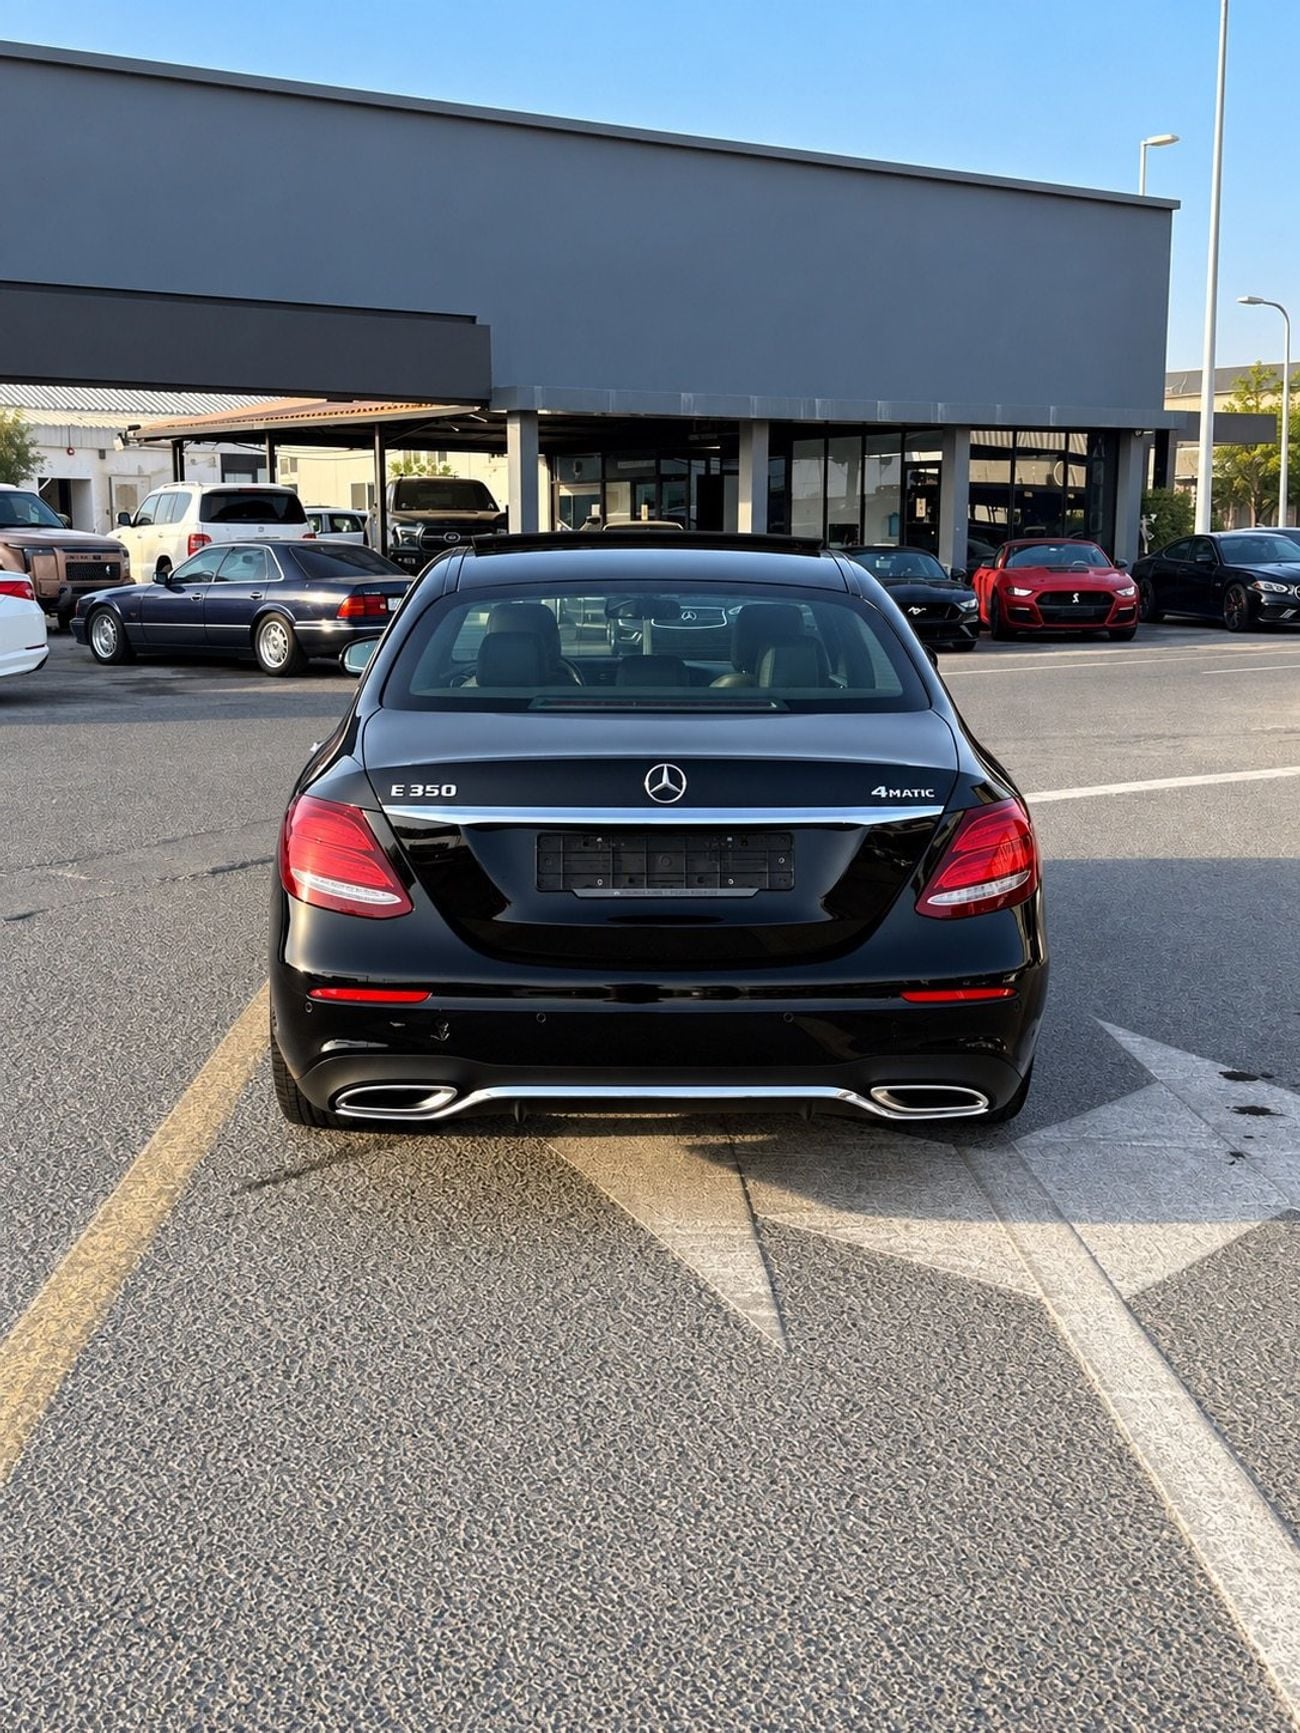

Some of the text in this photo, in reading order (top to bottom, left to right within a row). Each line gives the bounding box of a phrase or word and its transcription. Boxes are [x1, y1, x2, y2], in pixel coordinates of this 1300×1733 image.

[390, 784, 457, 797] E 350
[871, 785, 935, 798] 4MATIC
